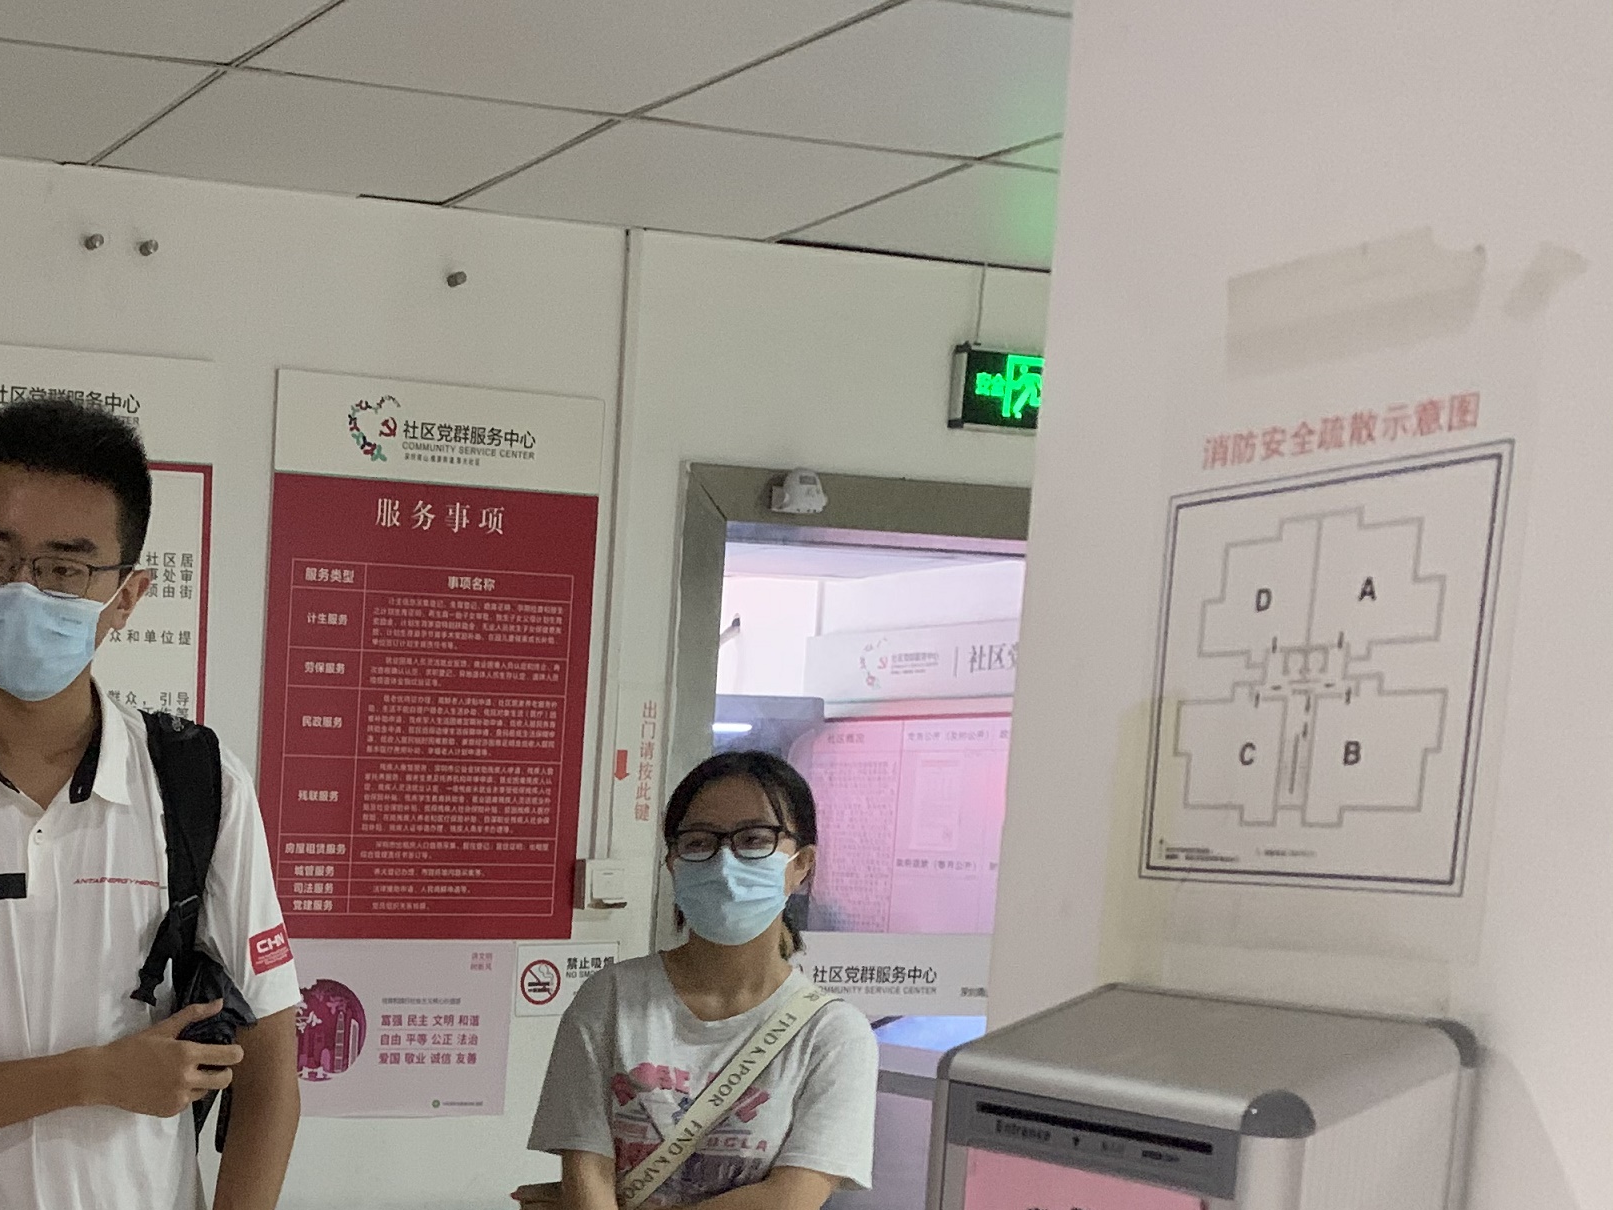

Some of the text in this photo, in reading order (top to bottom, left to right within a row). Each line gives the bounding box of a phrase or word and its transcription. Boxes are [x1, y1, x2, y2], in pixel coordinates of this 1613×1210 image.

[403, 420, 536, 449] 社区党群服务中心
[1202, 391, 1481, 470] 消防安全疏散示意图
[402, 441, 535, 460] COMMUNITY SERVICE CENTER
[375, 498, 505, 535] 服务事项
[305, 567, 495, 591] 服务类型 事项名称
[1256, 577, 1377, 612] D A
[307, 612, 348, 626] 计生服务
[304, 661, 345, 674] 劳保服务
[302, 714, 343, 728] 民政服务
[634, 700, 657, 821] 出门请按此键
[1239, 741, 1362, 766] C B
[298, 789, 338, 802] 残联服务
[285, 842, 346, 855] 房屋租赁服务
[294, 864, 334, 877] 城管服务
[293, 882, 334, 895] 司法服务
[292, 900, 333, 912] 党建服务
[566, 971, 577, 979] NO
[813, 965, 938, 985] 社区党群服务中心
[864, 986, 900, 996] SERVICE
[903, 986, 937, 996] CENTER
[381, 1014, 480, 1027] 富强 民主 文明 和谐
[763, 1012, 798, 1046] FIND
[380, 1033, 479, 1046] 自由 平等 公正 法治
[379, 1052, 477, 1065] 爱国 敬业 诚信 友善
